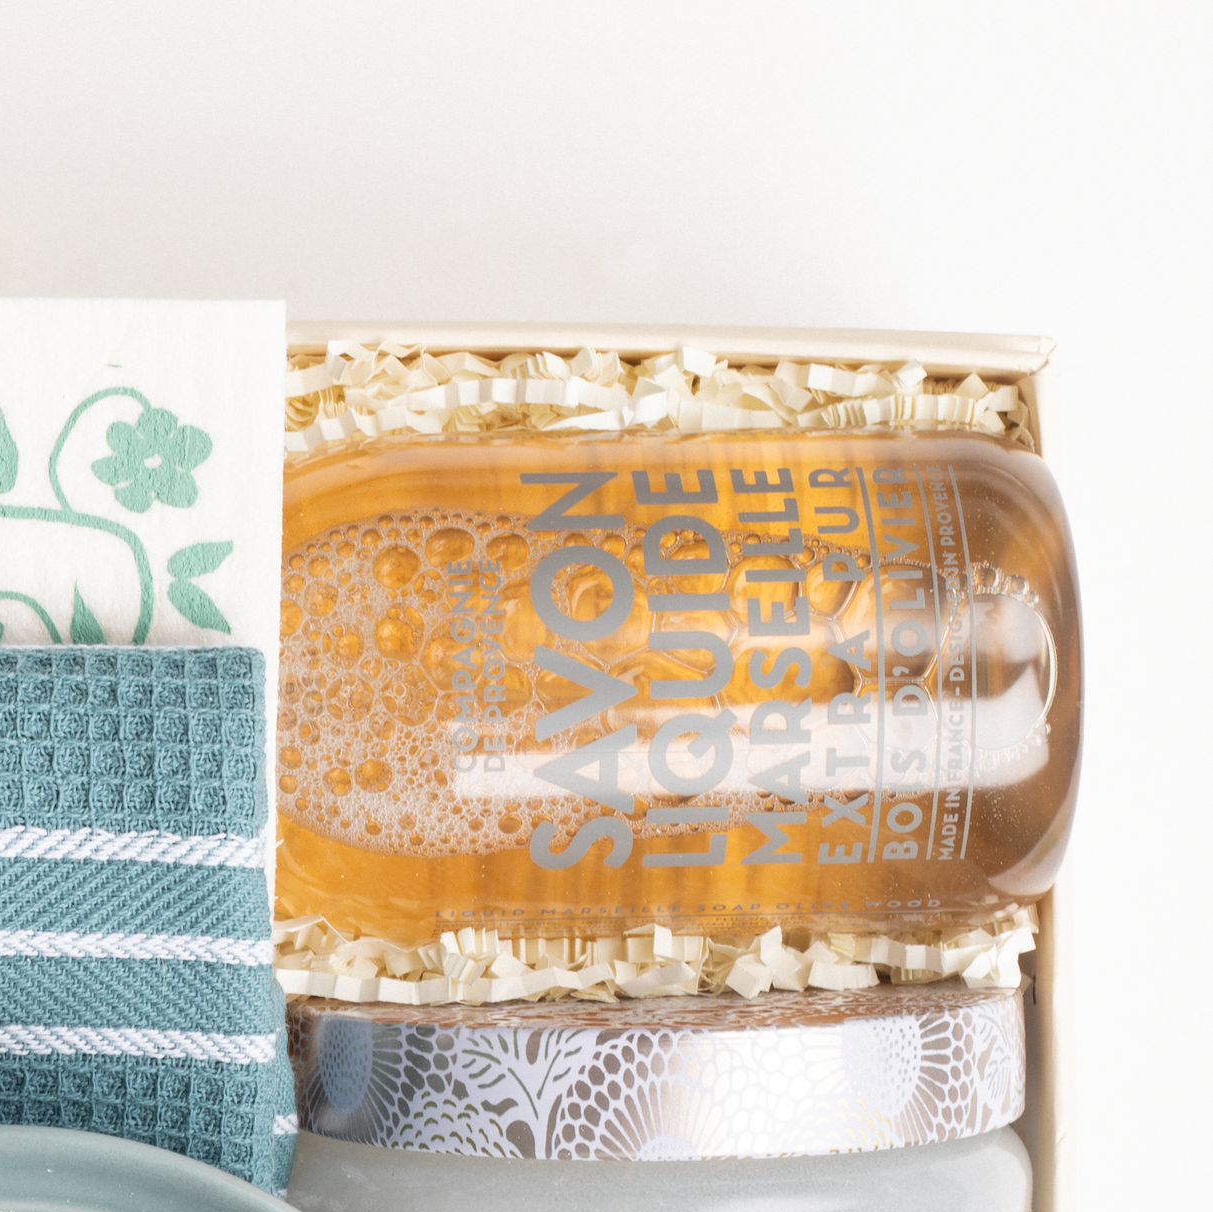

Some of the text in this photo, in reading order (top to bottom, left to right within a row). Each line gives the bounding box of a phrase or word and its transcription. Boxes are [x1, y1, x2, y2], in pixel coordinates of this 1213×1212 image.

[925, 464, 955, 547] PROVENCE
[941, 553, 959, 573] IN
[447, 560, 478, 773] COMPAGNIE
[479, 559, 506, 773] DE PROVENCE
[519, 471, 638, 870] SAVON
[631, 468, 741, 868] LIQUIDE
[730, 466, 813, 866] MARSEILLE
[808, 466, 873, 866] EXTRA PUR
[945, 576, 965, 682] DESIGNED
[948, 700, 965, 782] FRANCE
[881, 748, 928, 861] BOIS
[937, 812, 960, 861] MADE
[943, 788, 961, 808] IN
[435, 899, 942, 918] LIQUID MARSEILLE SOAP OLIVE WOOD
